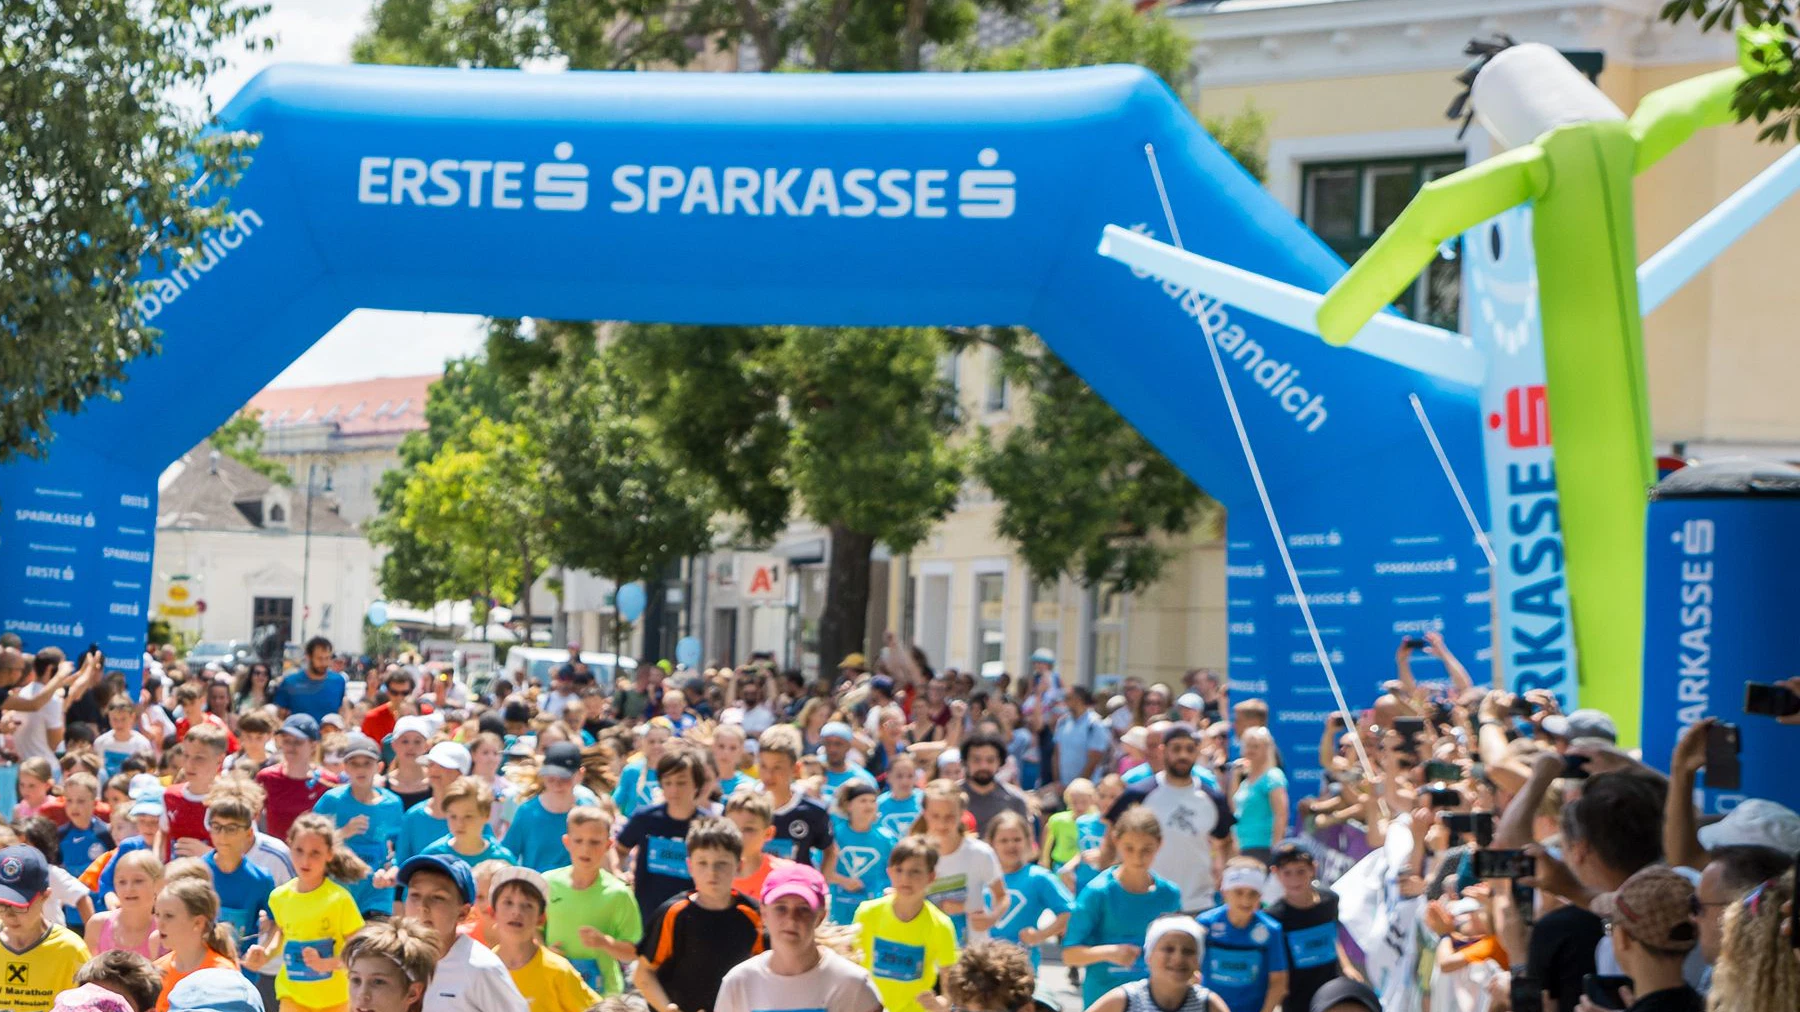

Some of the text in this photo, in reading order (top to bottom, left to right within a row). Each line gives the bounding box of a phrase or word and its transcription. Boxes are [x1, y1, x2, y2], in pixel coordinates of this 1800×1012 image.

[358, 155, 949, 218] ERSTE SPARKASSE
[15, 508, 83, 527] SPARKASSE
[26, 565, 61, 579] ERSTE
[750, 563, 781, 594] A1
[4, 619, 71, 636] SPARKASSE
[1676, 560, 1714, 742] ARKASSE
